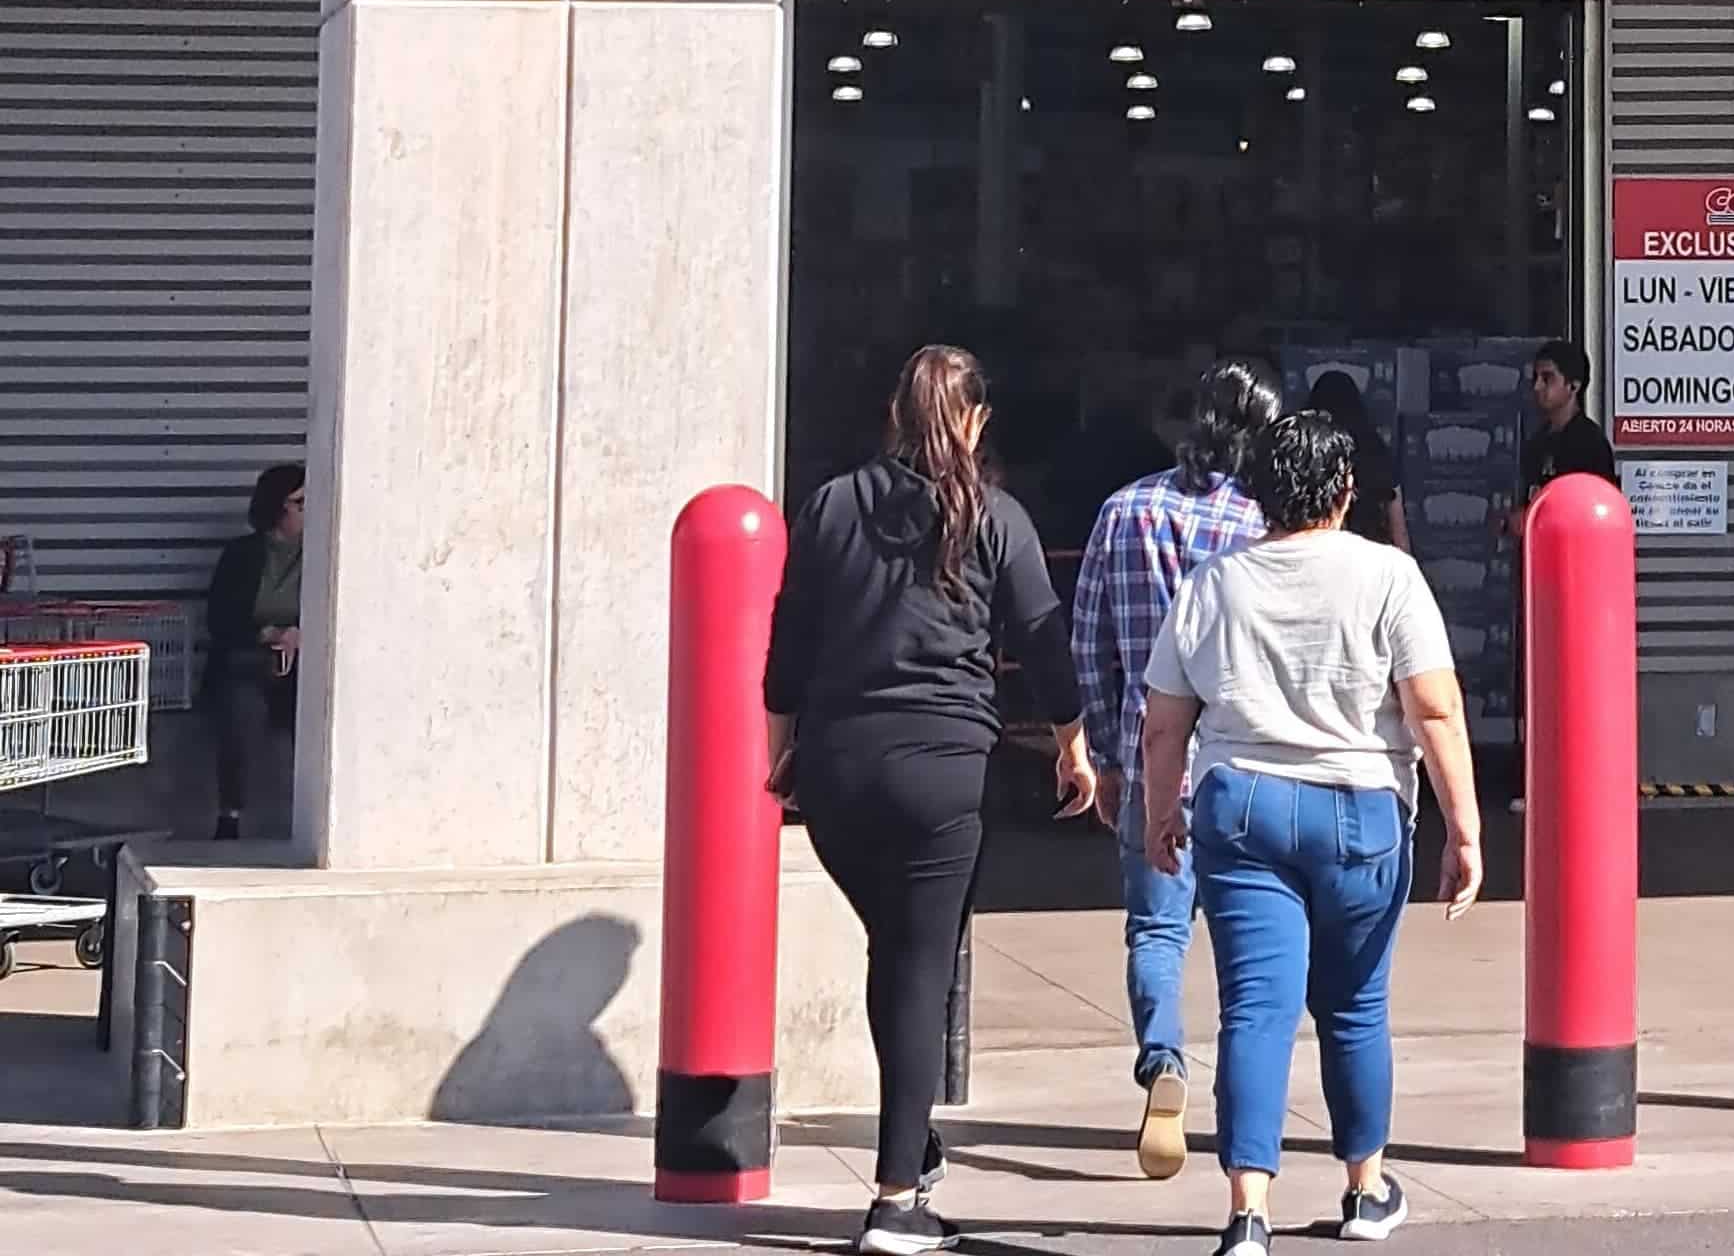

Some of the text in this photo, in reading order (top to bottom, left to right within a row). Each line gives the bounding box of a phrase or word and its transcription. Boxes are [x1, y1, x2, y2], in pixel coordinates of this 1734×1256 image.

[1623, 276, 1677, 304] LUN
[1621, 419, 1677, 434] ABIERTO
[1678, 419, 1694, 434] 24
